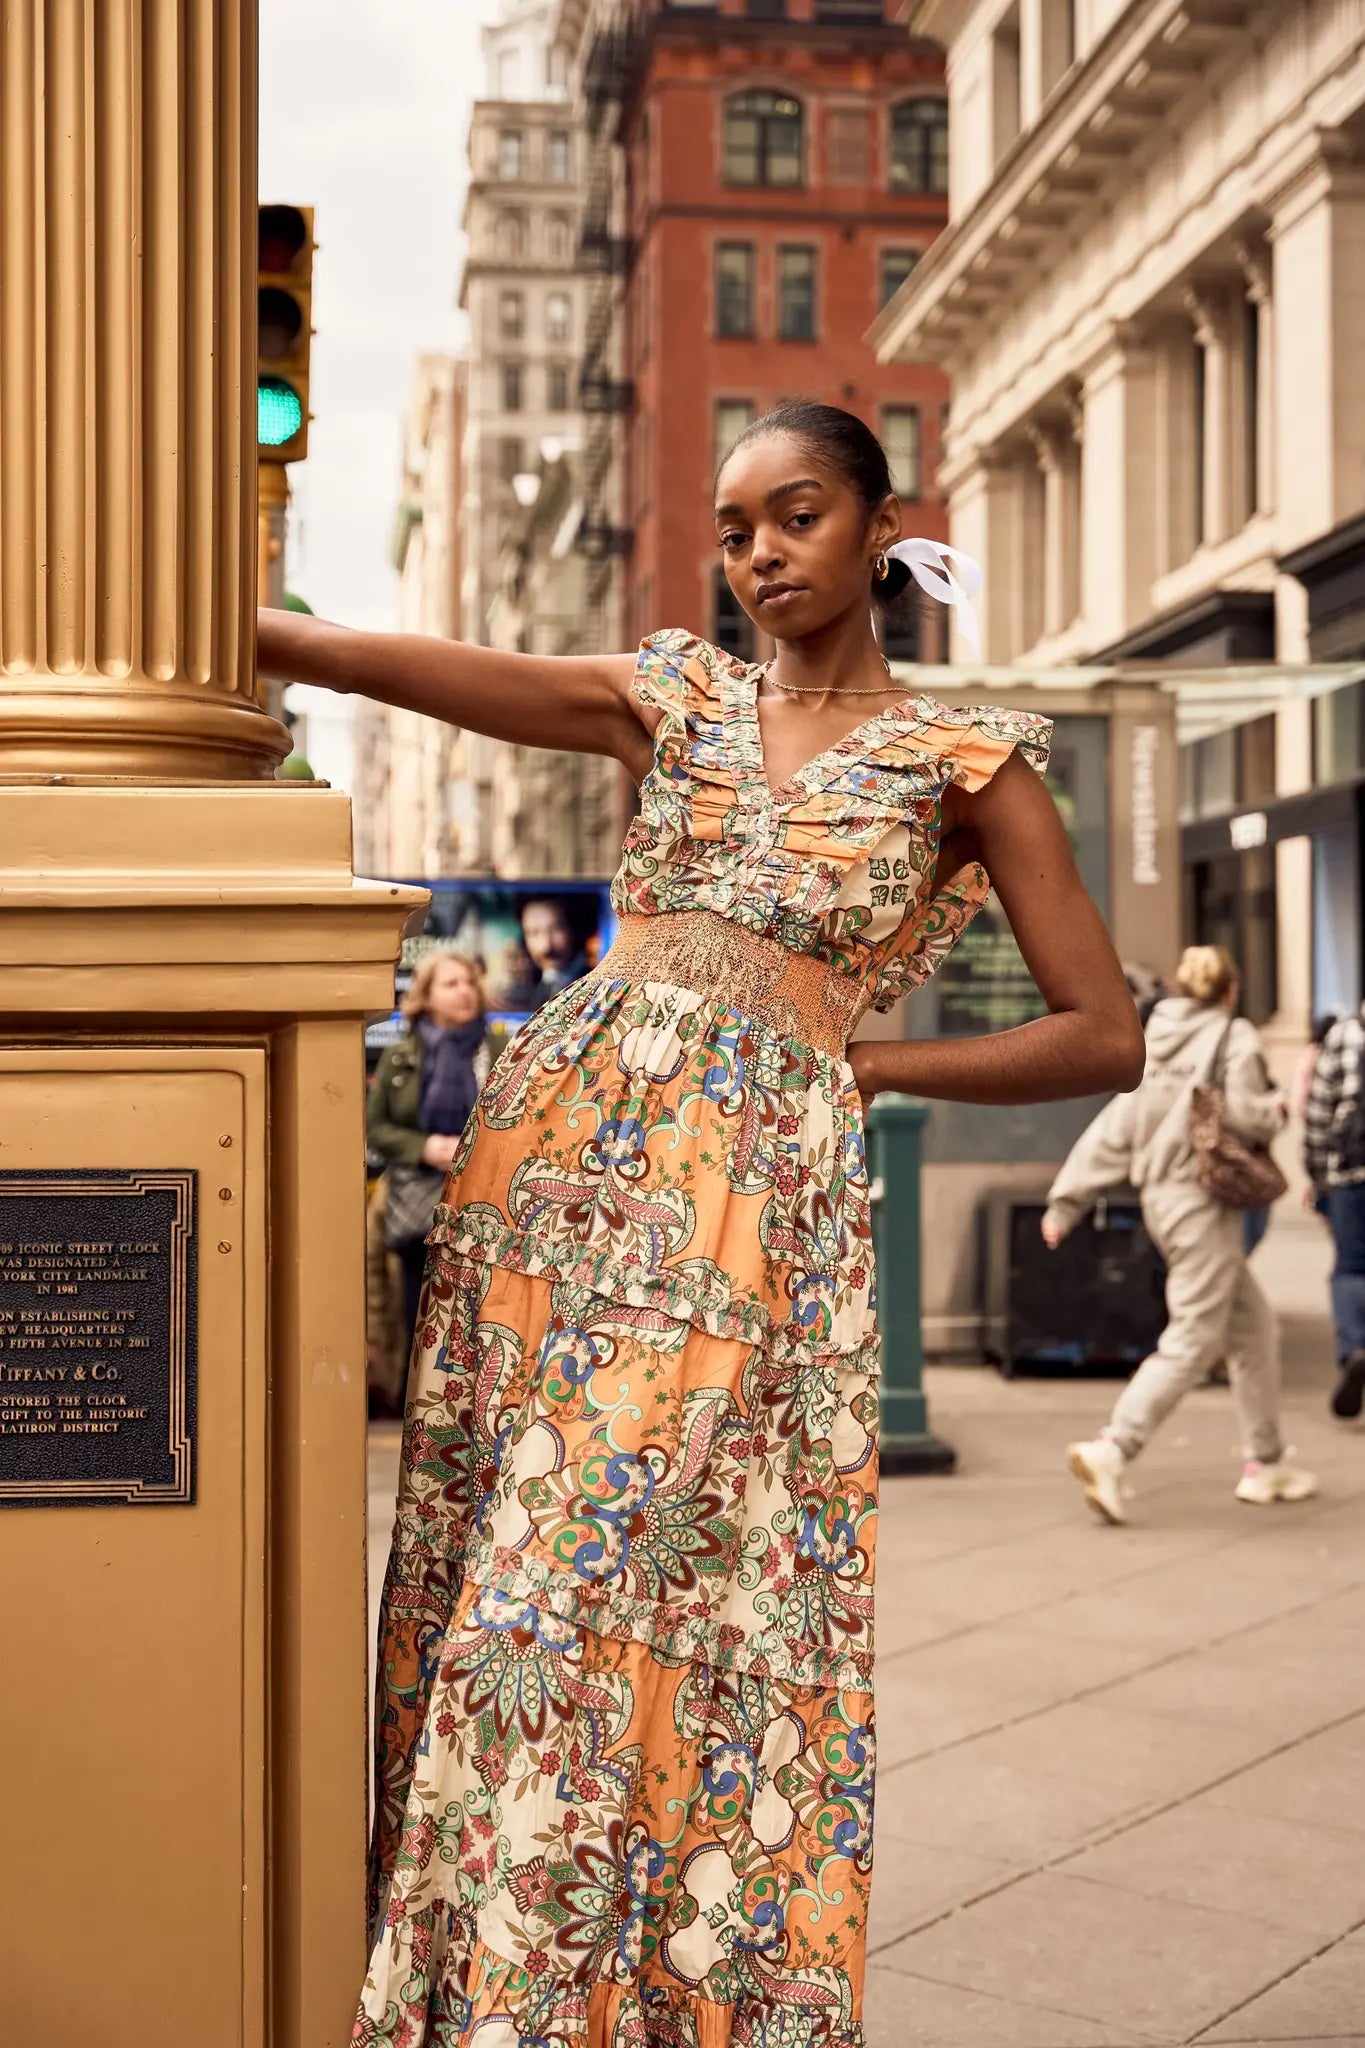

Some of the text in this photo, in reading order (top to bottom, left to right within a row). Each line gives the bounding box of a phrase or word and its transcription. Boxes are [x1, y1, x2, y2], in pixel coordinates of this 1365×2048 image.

[0, 1243, 161, 1254] 09 ICONIC STREET CLOCK
[28, 1258, 107, 1268] DESIGNATED
[113, 1258, 121, 1267] A
[3, 1270, 148, 1281] YORK CITY LANDMARK
[36, 1285, 78, 1295] IN 1981
[20, 1311, 110, 1321] ESTABLISHING
[116, 1311, 136, 1321] ITS
[25, 1325, 125, 1336] HEADQUARTERS
[10, 1339, 46, 1349] FIFTH
[51, 1338, 102, 1348] AVENUE
[109, 1338, 122, 1348] IN
[128, 1337, 150, 1347] 2011
[74, 1366, 86, 1381] &
[0, 1395, 127, 1406] STORED THE CLOCK
[1, 1409, 148, 1420] GIFT TO THE HISTORIC
[1, 1424, 119, 1434] LATIRON DISTRICT
